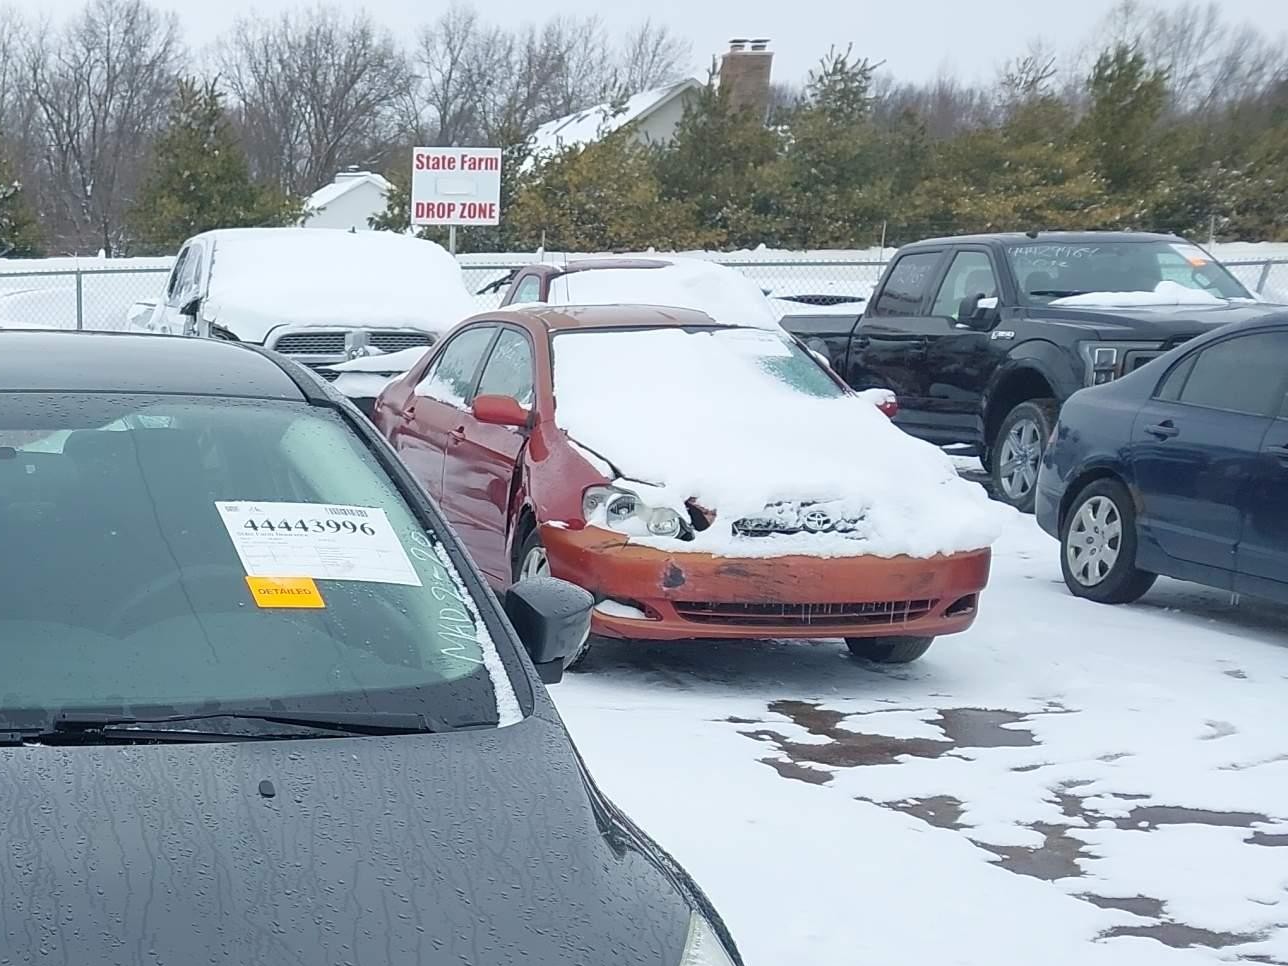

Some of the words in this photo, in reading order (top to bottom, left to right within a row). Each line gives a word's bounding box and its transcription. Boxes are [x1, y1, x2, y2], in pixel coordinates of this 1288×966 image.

[415, 153, 456, 170] State
[460, 154, 499, 171] Farm
[415, 202, 456, 219] DROP
[459, 203, 496, 219] ZONE
[243, 518, 376, 537] 44443996
[258, 587, 312, 596] DETAILED
